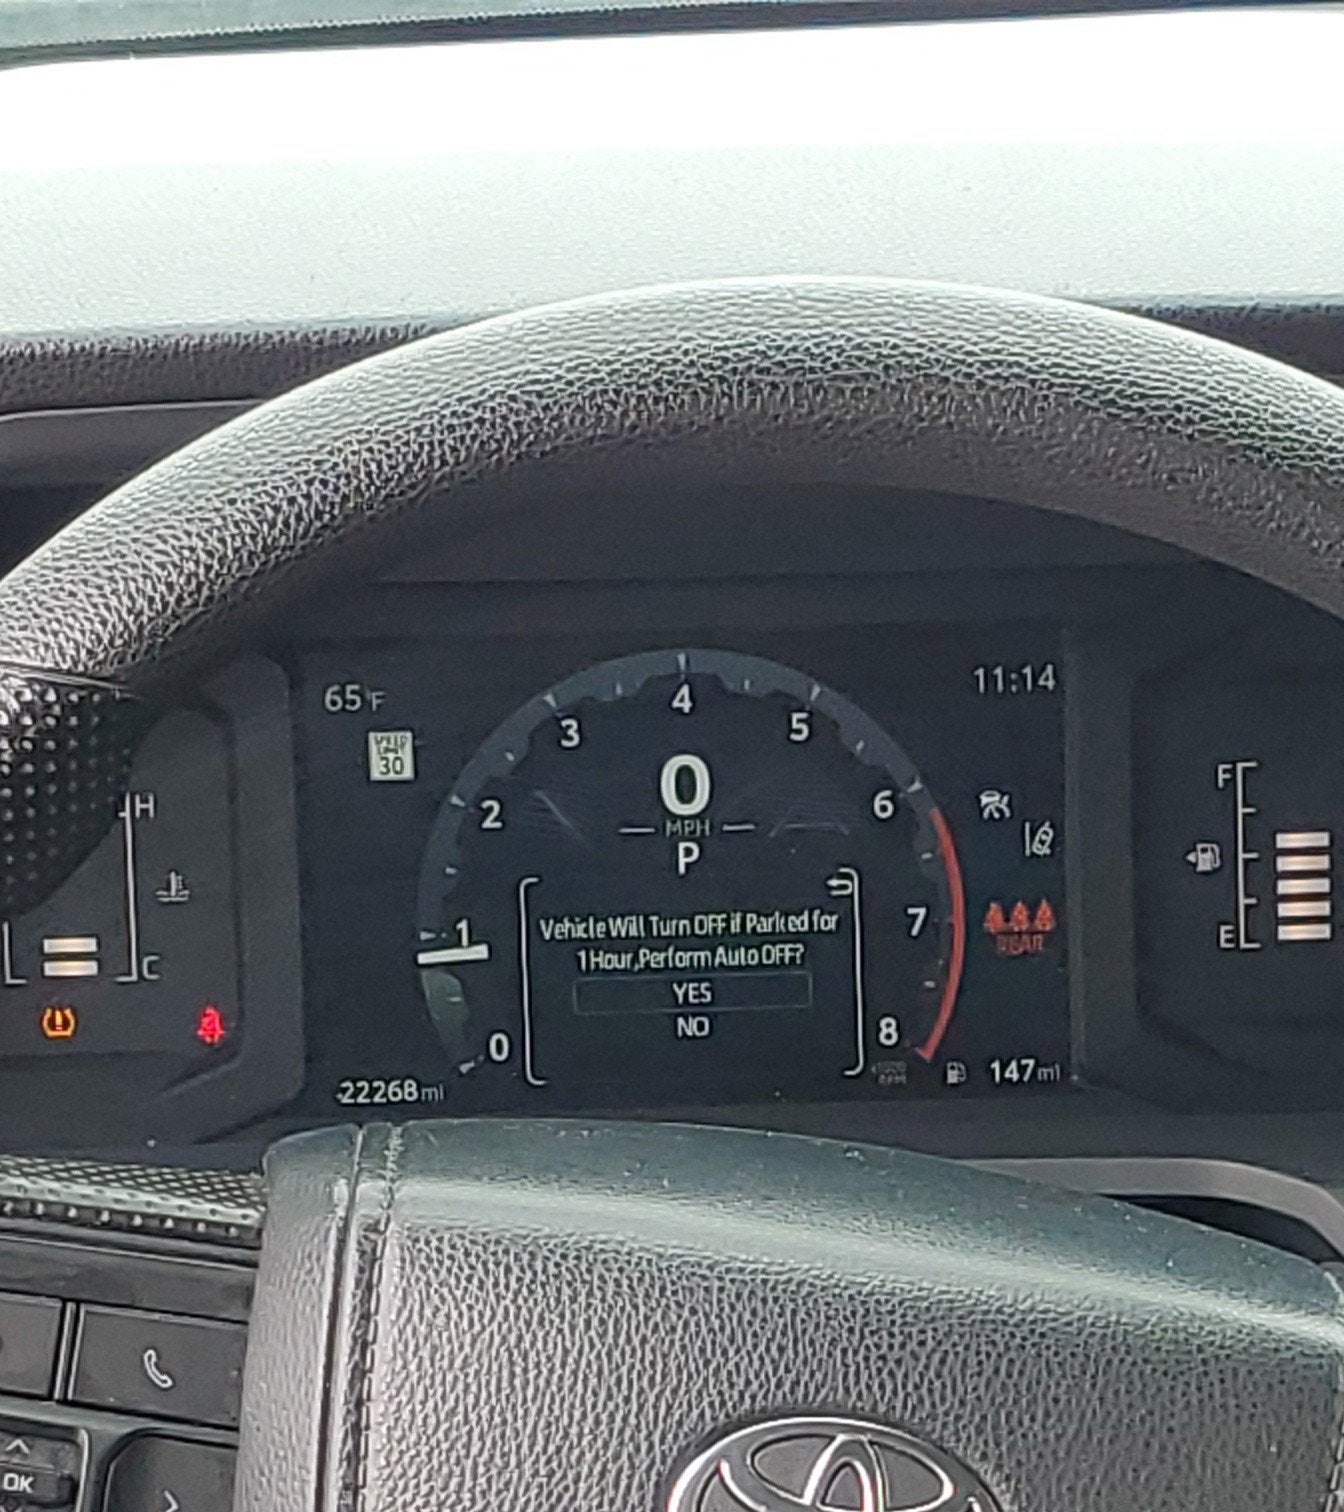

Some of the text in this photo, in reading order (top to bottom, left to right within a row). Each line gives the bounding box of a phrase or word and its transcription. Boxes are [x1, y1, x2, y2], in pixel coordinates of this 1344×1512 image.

[973, 663, 1056, 695] 11:14
[671, 684, 694, 714] 4
[560, 718, 581, 748] 3
[789, 712, 810, 742] 5
[379, 755, 405, 776] 30
[1217, 763, 1234, 789] F
[660, 753, 711, 816] 0
[134, 793, 155, 819] H
[480, 800, 503, 830] 2
[872, 790, 895, 819] 6
[665, 818, 711, 838] MPH
[677, 840, 700, 876] P
[456, 918, 469, 948] 1
[539, 908, 839, 940] Vehicle Will Turn OFF if Parked for
[906, 906, 927, 936] 7
[1219, 924, 1236, 948] E
[142, 955, 161, 980] C
[577, 950, 587, 971] 1
[714, 946, 759, 968] Auto
[762, 943, 806, 966] OFF?
[672, 982, 712, 1004] YES
[676, 1016, 710, 1039] NO
[877, 1016, 899, 1046] 8
[488, 1032, 510, 1061] 0
[2, 1472, 35, 1494] OK
